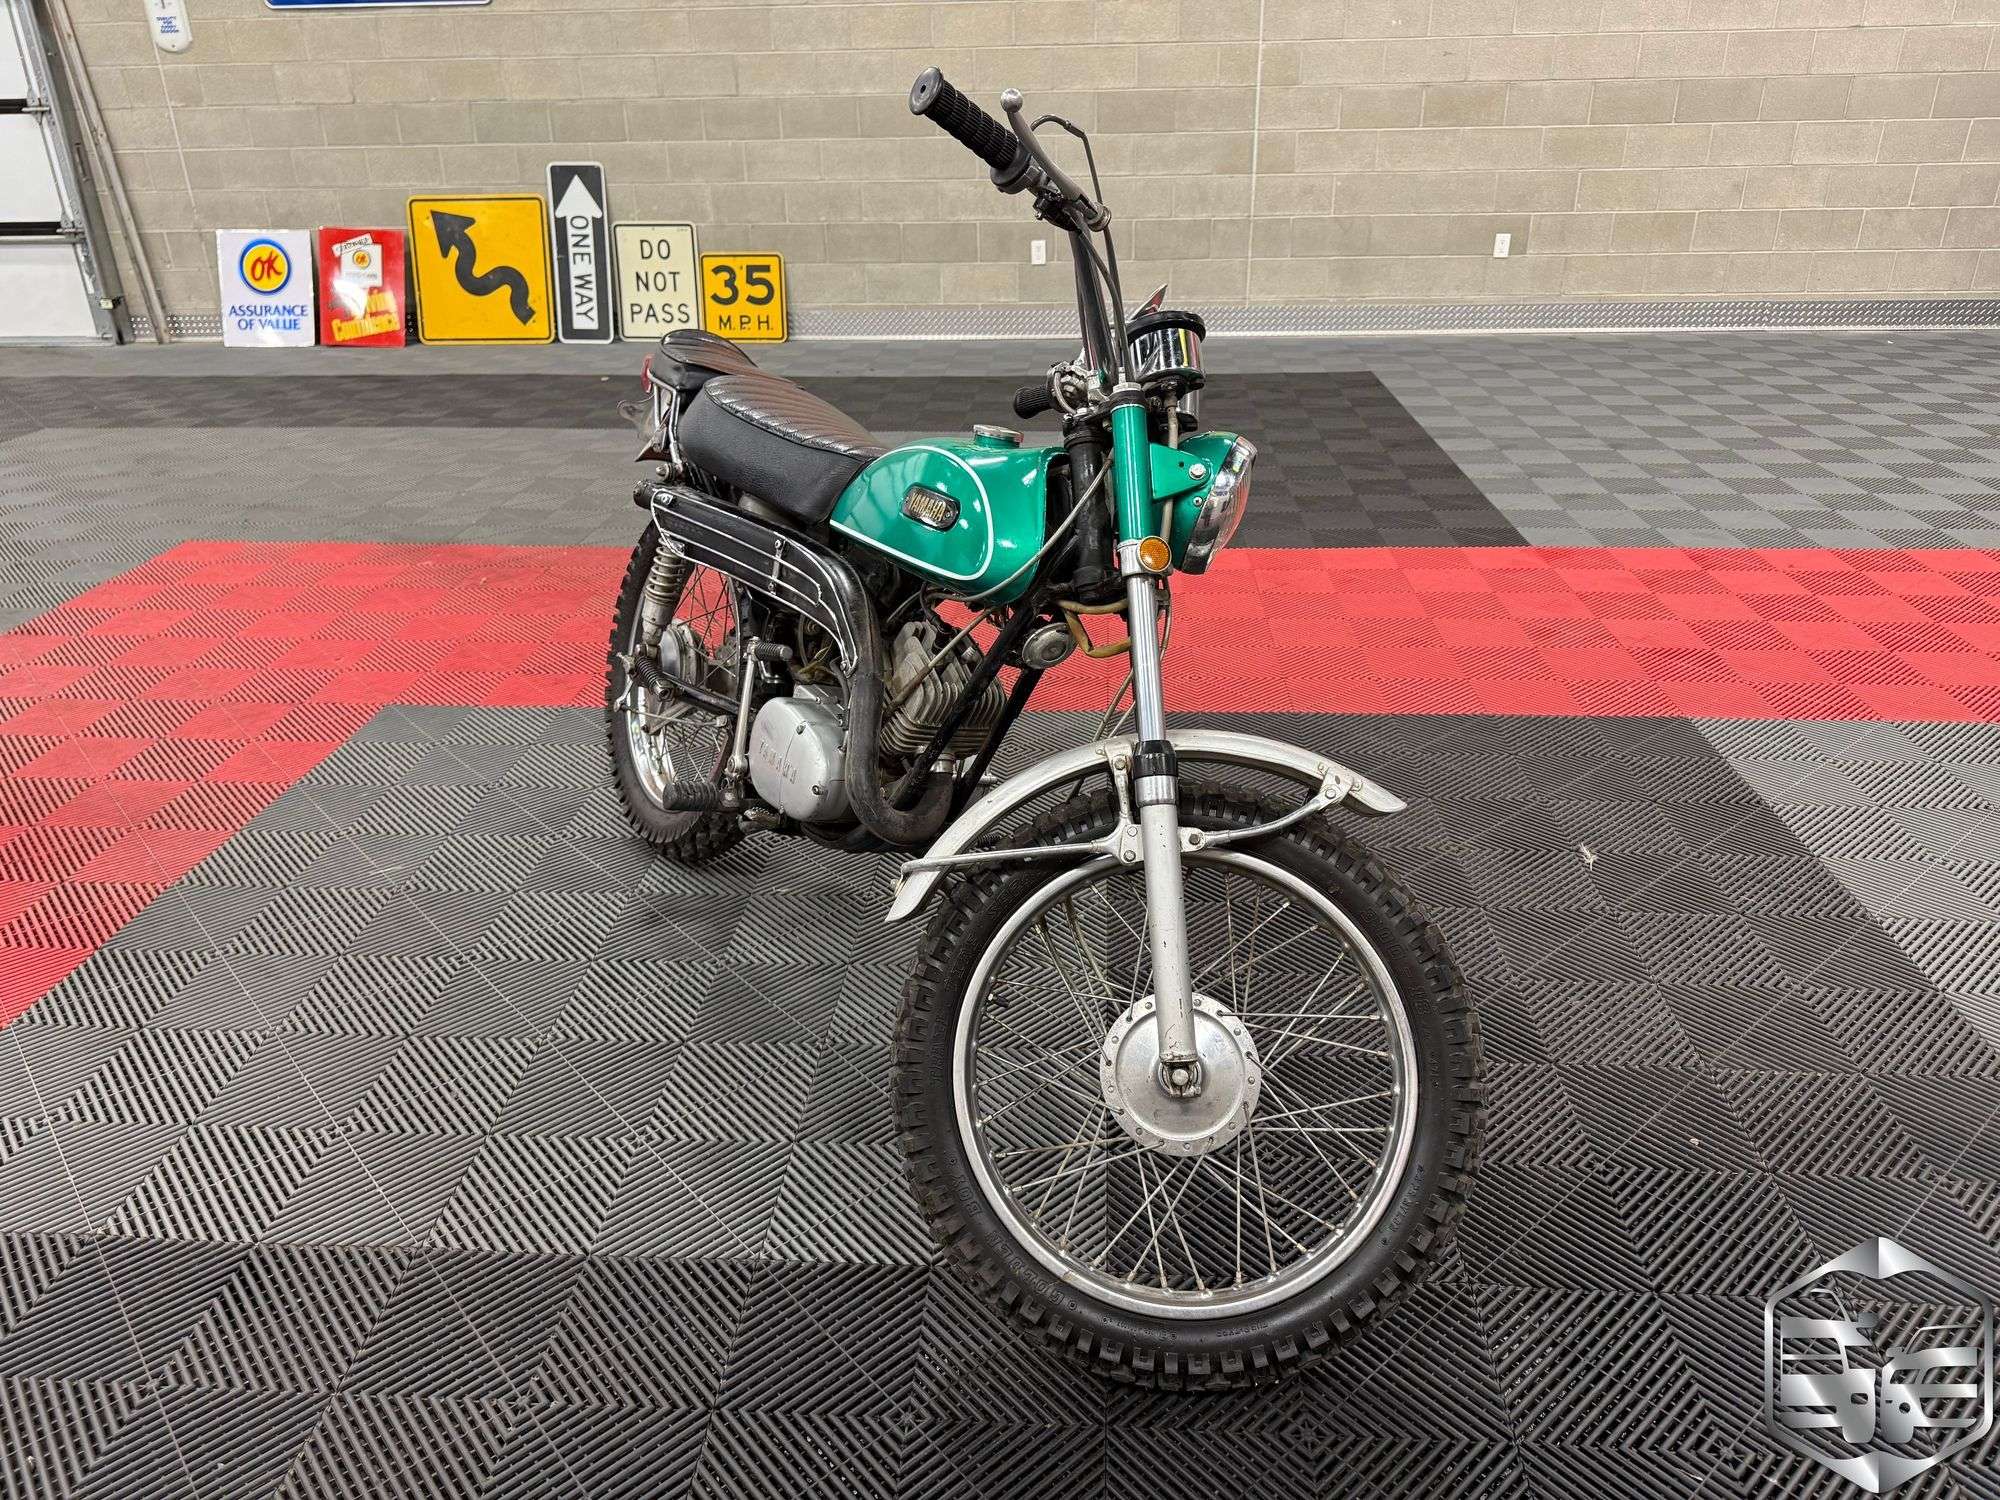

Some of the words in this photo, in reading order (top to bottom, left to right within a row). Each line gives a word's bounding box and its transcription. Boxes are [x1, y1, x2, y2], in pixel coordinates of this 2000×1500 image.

[570, 215, 592, 265] ONE
[639, 239, 671, 260] DO
[251, 250, 283, 282] OK
[635, 271, 681, 292] NOT
[710, 265, 775, 306] 35
[229, 304, 309, 317] ASSURANCE
[573, 274, 595, 322] WAY
[237, 318, 256, 331] OF
[258, 318, 301, 331] VALUE
[629, 303, 691, 324] PASS
[908, 491, 947, 522] YAMAHA
